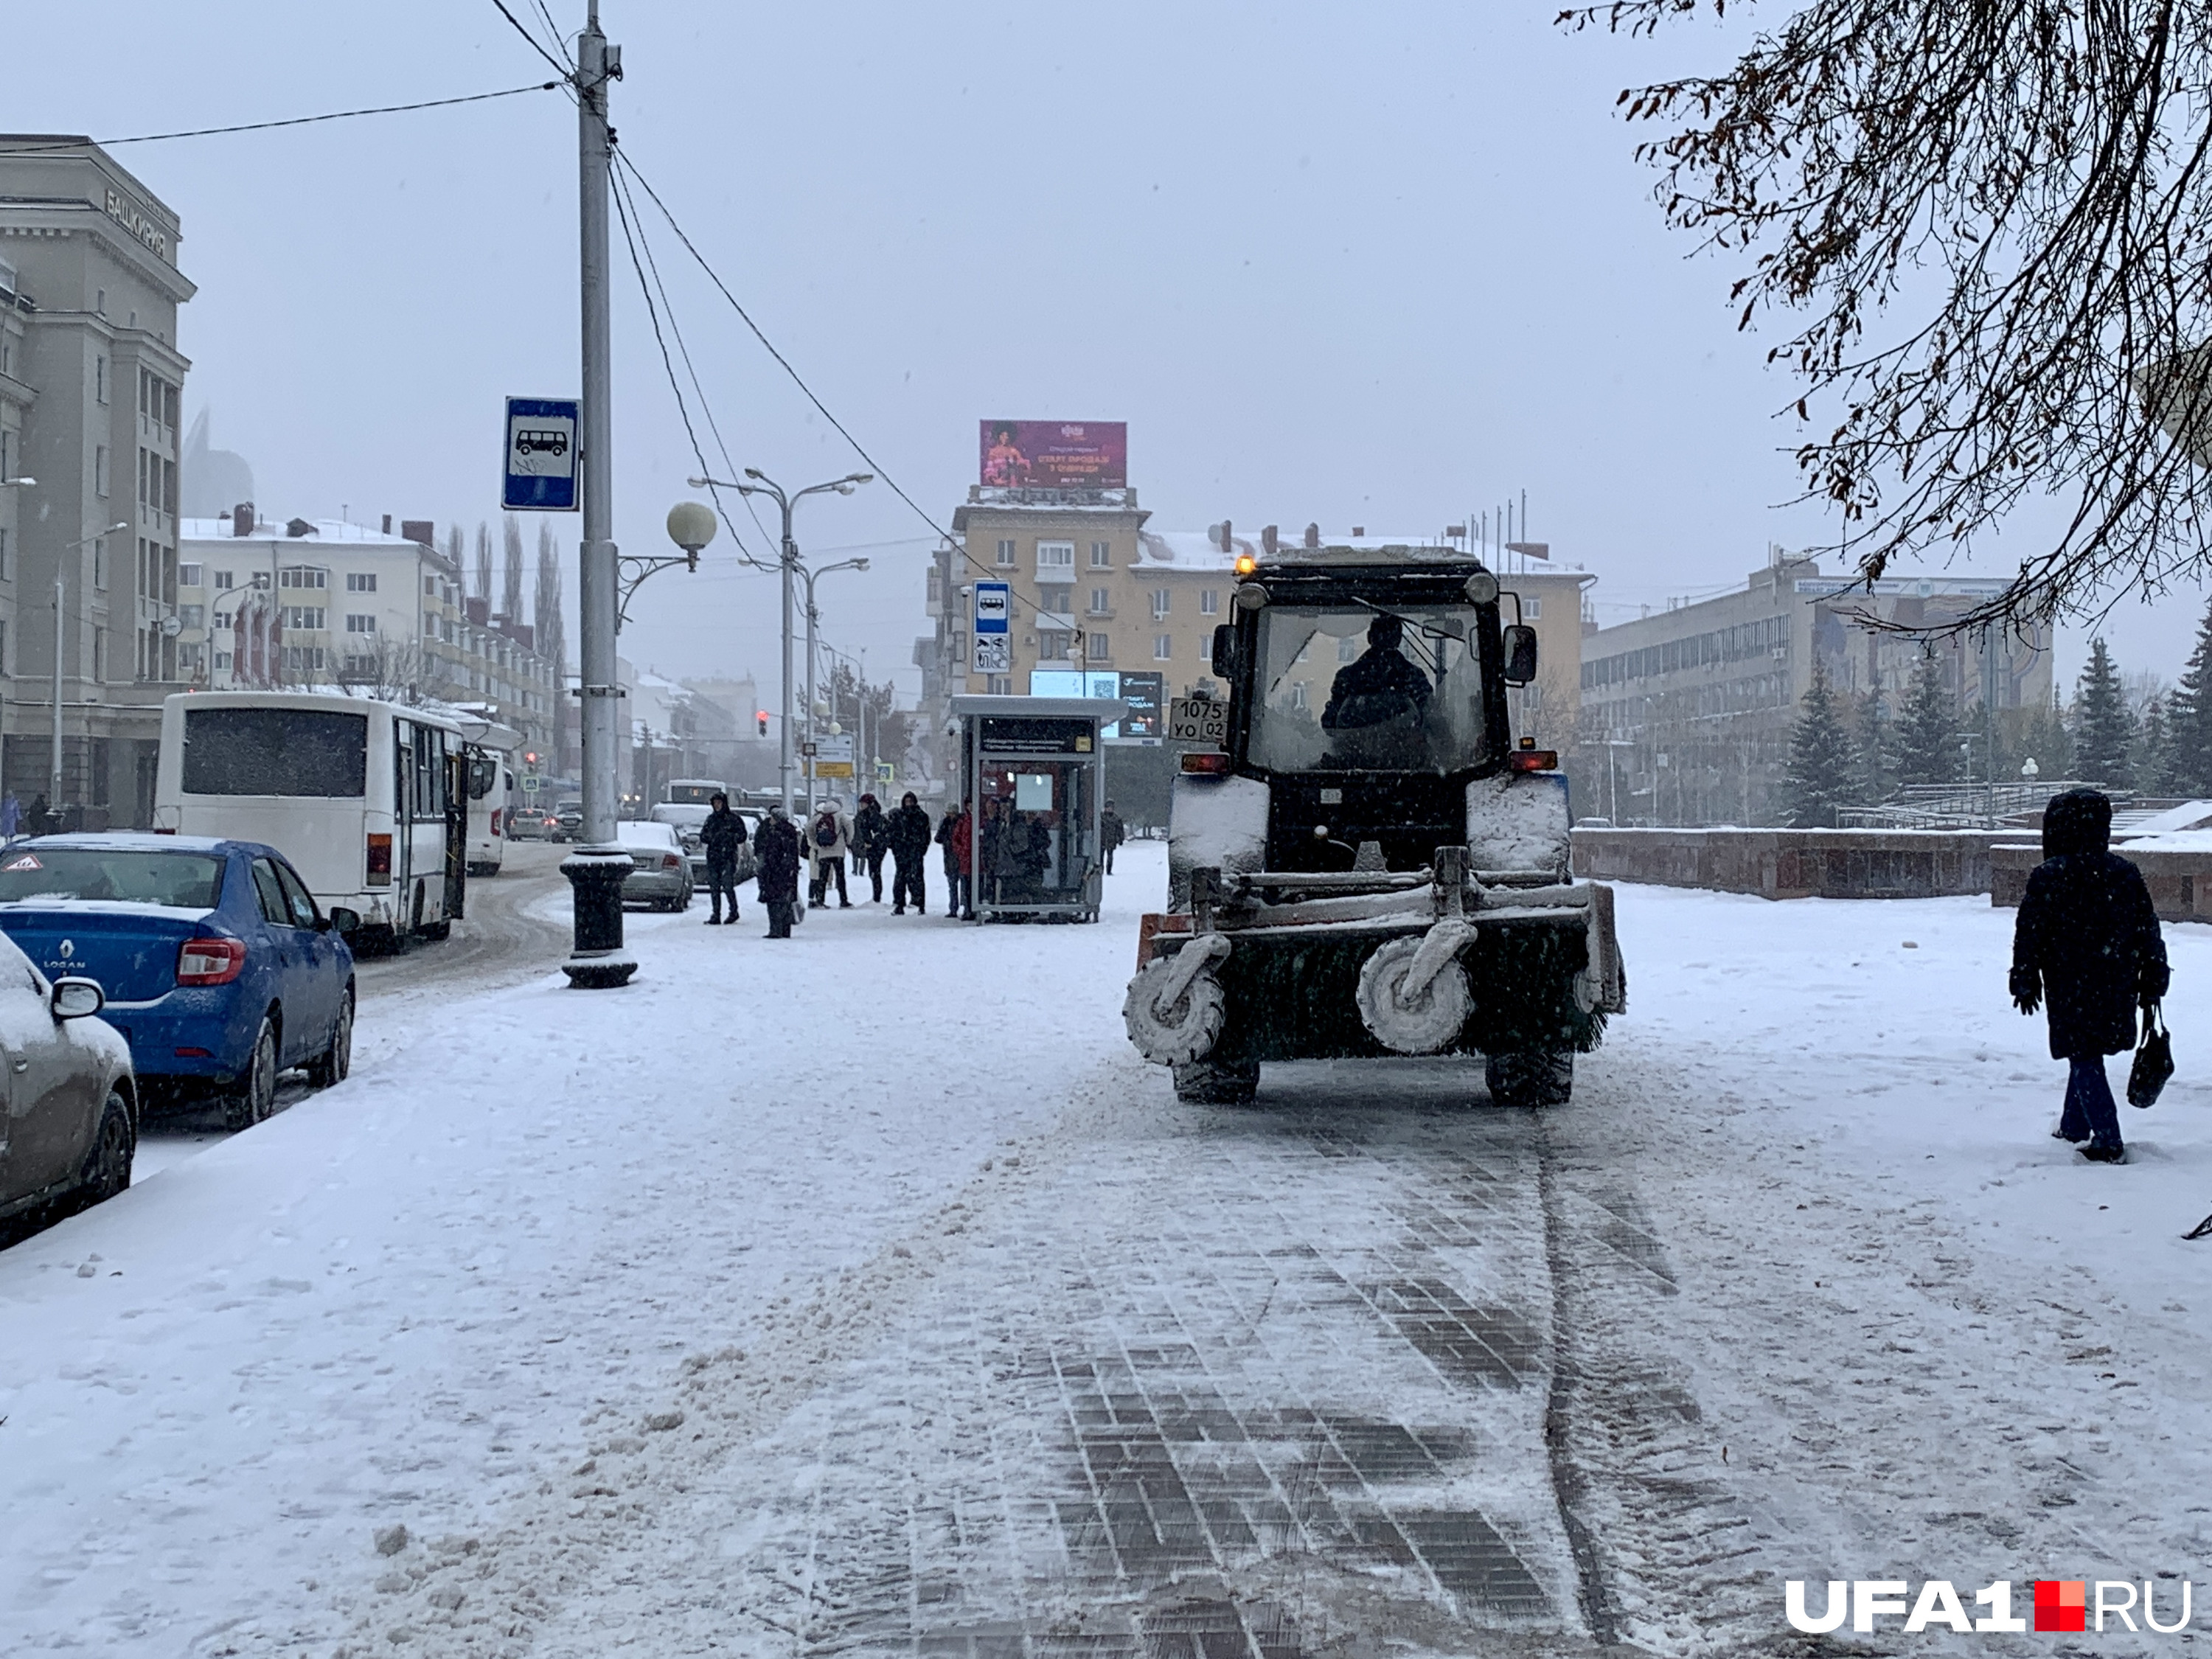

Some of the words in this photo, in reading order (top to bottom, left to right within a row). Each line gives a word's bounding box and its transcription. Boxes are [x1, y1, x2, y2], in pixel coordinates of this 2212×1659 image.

[107, 189, 166, 257] БАШКИРИЯ
[1180, 701, 1222, 719] 1075
[1175, 723, 1196, 737] УО
[1206, 723, 1223, 736] 02
